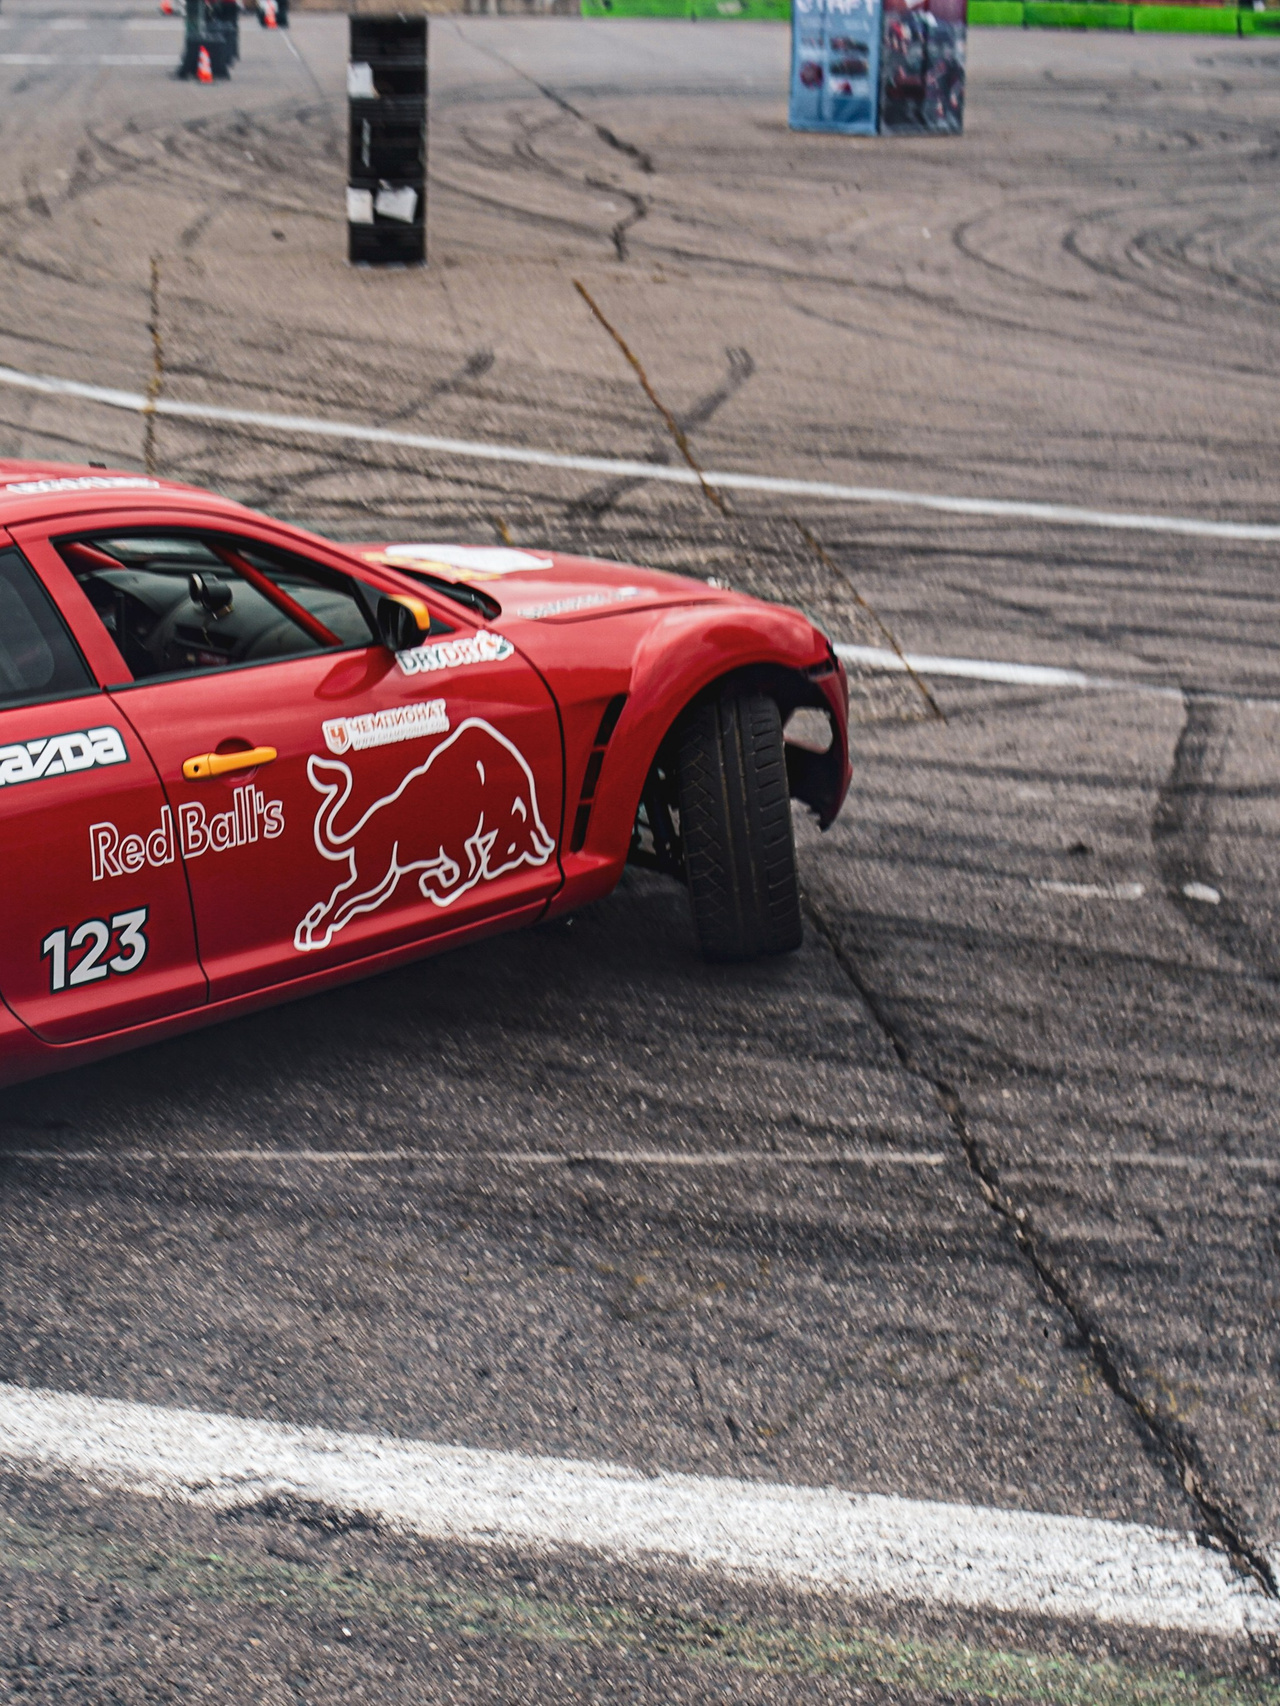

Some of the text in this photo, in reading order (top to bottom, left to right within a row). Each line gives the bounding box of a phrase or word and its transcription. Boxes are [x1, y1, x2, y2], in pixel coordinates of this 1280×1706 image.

[349, 703, 445, 735] ЧЕМПИОНАТ
[89, 784, 286, 881] Red Ball's
[40, 904, 149, 994] 123
